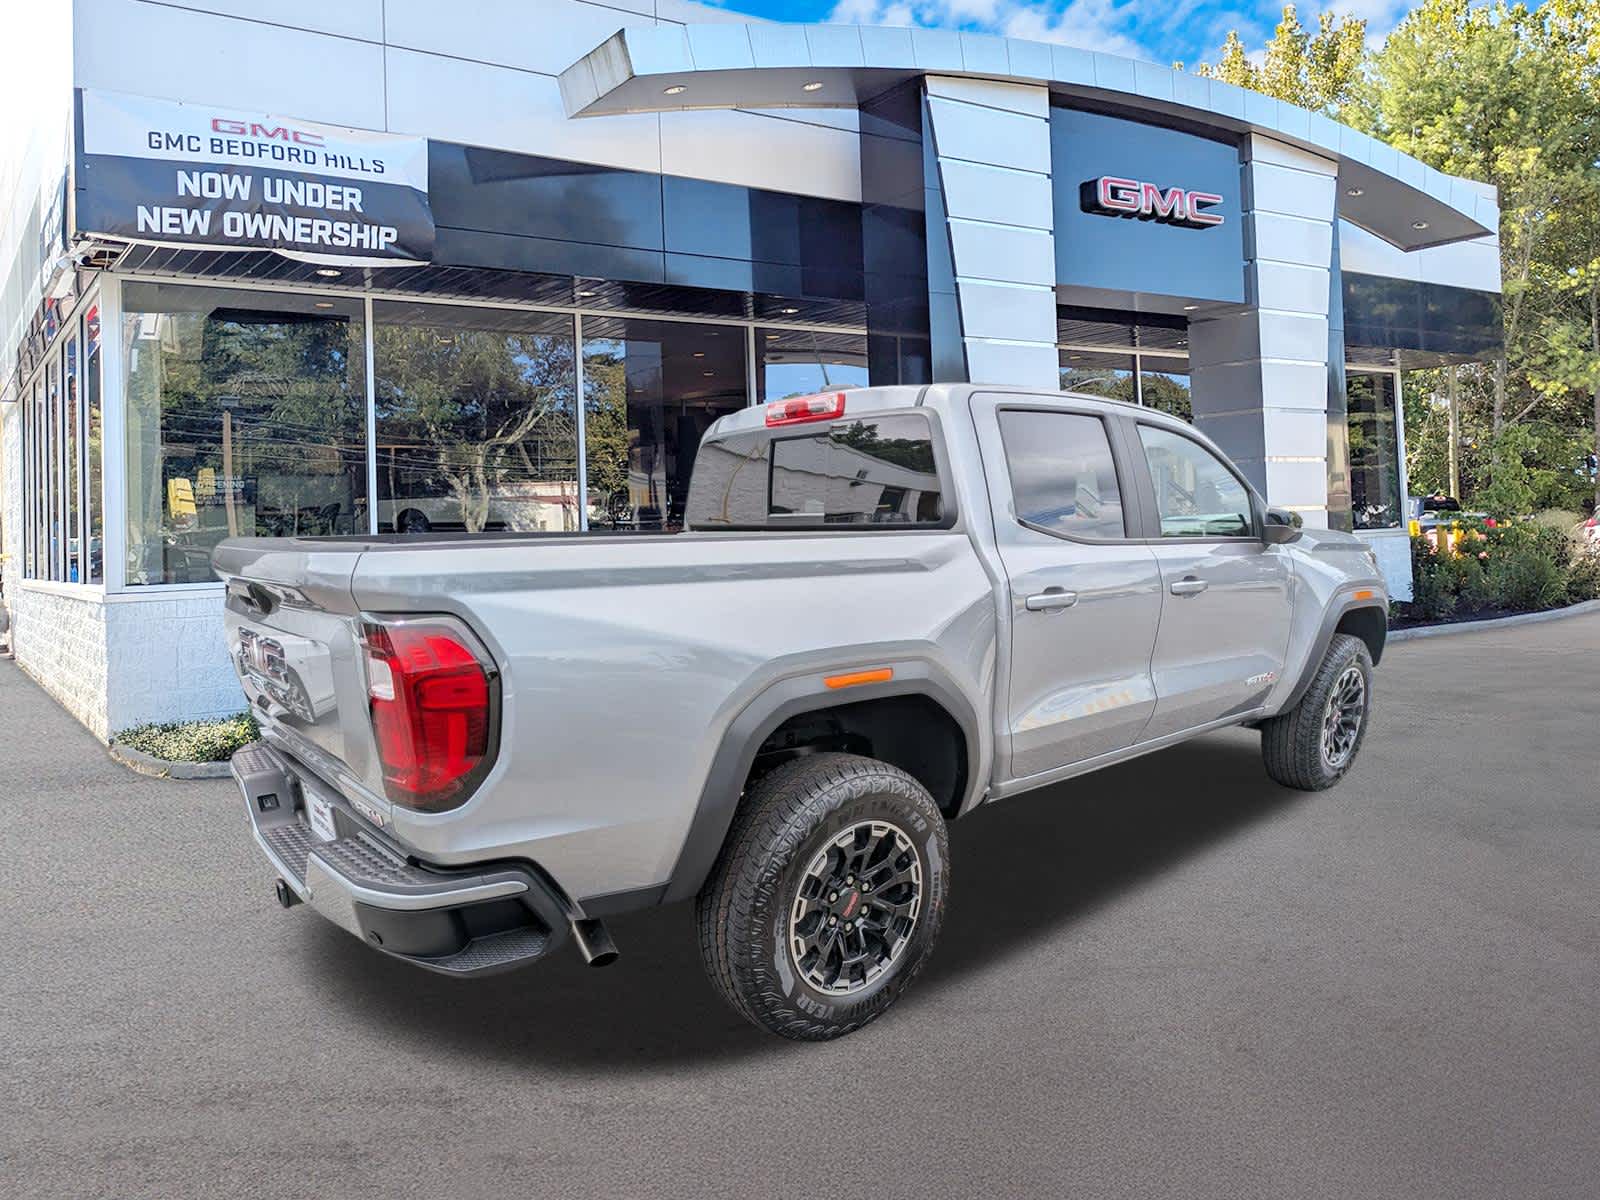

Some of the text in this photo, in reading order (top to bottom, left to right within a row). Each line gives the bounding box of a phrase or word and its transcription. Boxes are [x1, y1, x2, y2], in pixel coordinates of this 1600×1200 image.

[148, 131, 385, 174] GMC BEDFORD HILLS
[211, 118, 326, 148] GMC
[177, 170, 364, 213] NOW UNDER
[1097, 175, 1225, 224] GMC
[136, 205, 398, 250] NEW OWNERSHIP
